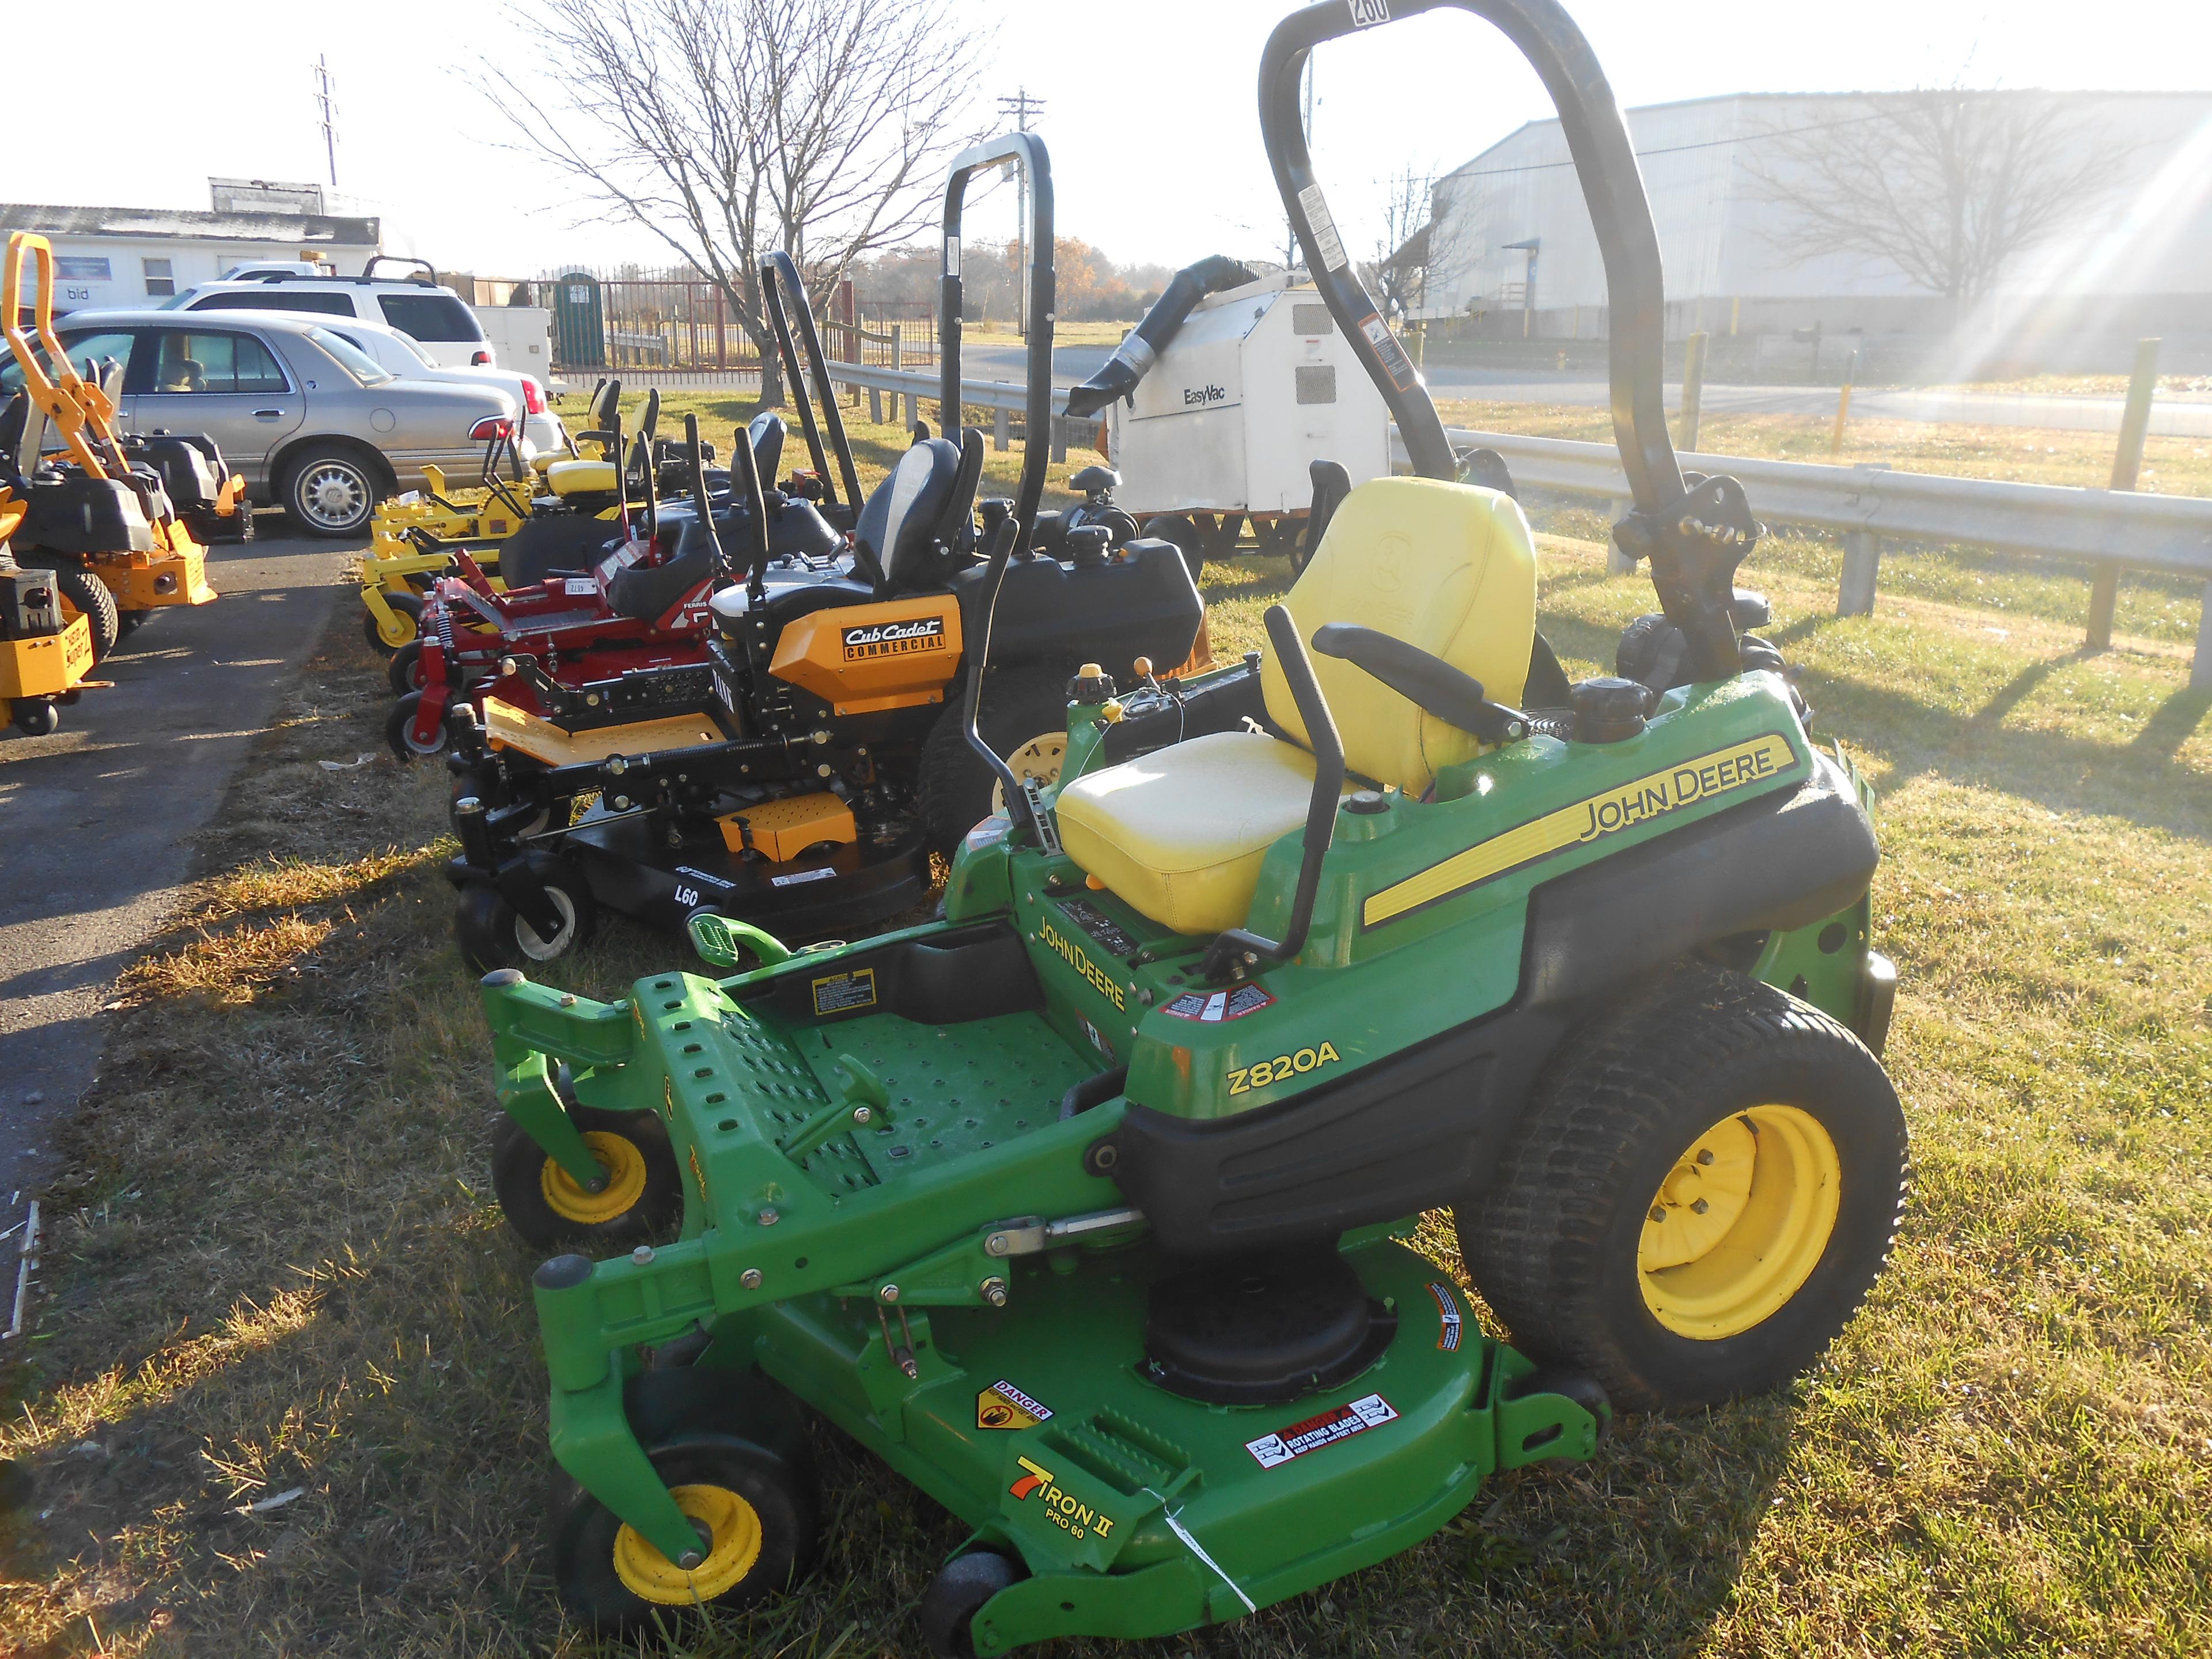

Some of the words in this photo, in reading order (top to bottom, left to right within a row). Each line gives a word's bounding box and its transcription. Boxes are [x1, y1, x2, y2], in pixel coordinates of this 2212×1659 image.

[67, 289, 89, 300] bid
[1184, 384, 1225, 406] EasyVac
[683, 601, 707, 609] FERRIS
[846, 627, 881, 645] Cub
[881, 620, 941, 640] Cadet
[847, 635, 943, 658] COMMERCIAL
[1580, 782, 1670, 839] JOHN
[1673, 747, 1775, 803] DEERE
[1039, 915, 1074, 966] JOHN
[1075, 944, 1125, 1012] DEERE
[1227, 1041, 1340, 1096] Z820A
[996, 1382, 1048, 1418] DANGER
[1286, 1426, 1330, 1449] ROTATING
[1328, 1415, 1362, 1433] BLADES
[1294, 1445, 1308, 1455] KEEP
[1308, 1438, 1327, 1449] HANDS
[1327, 1433, 1336, 1442] and
[1336, 1430, 1351, 1439] FEET
[1350, 1423, 1366, 1434] AWAY
[1046, 1508, 1069, 1529] PRO
[1070, 1524, 1084, 1540] 60
